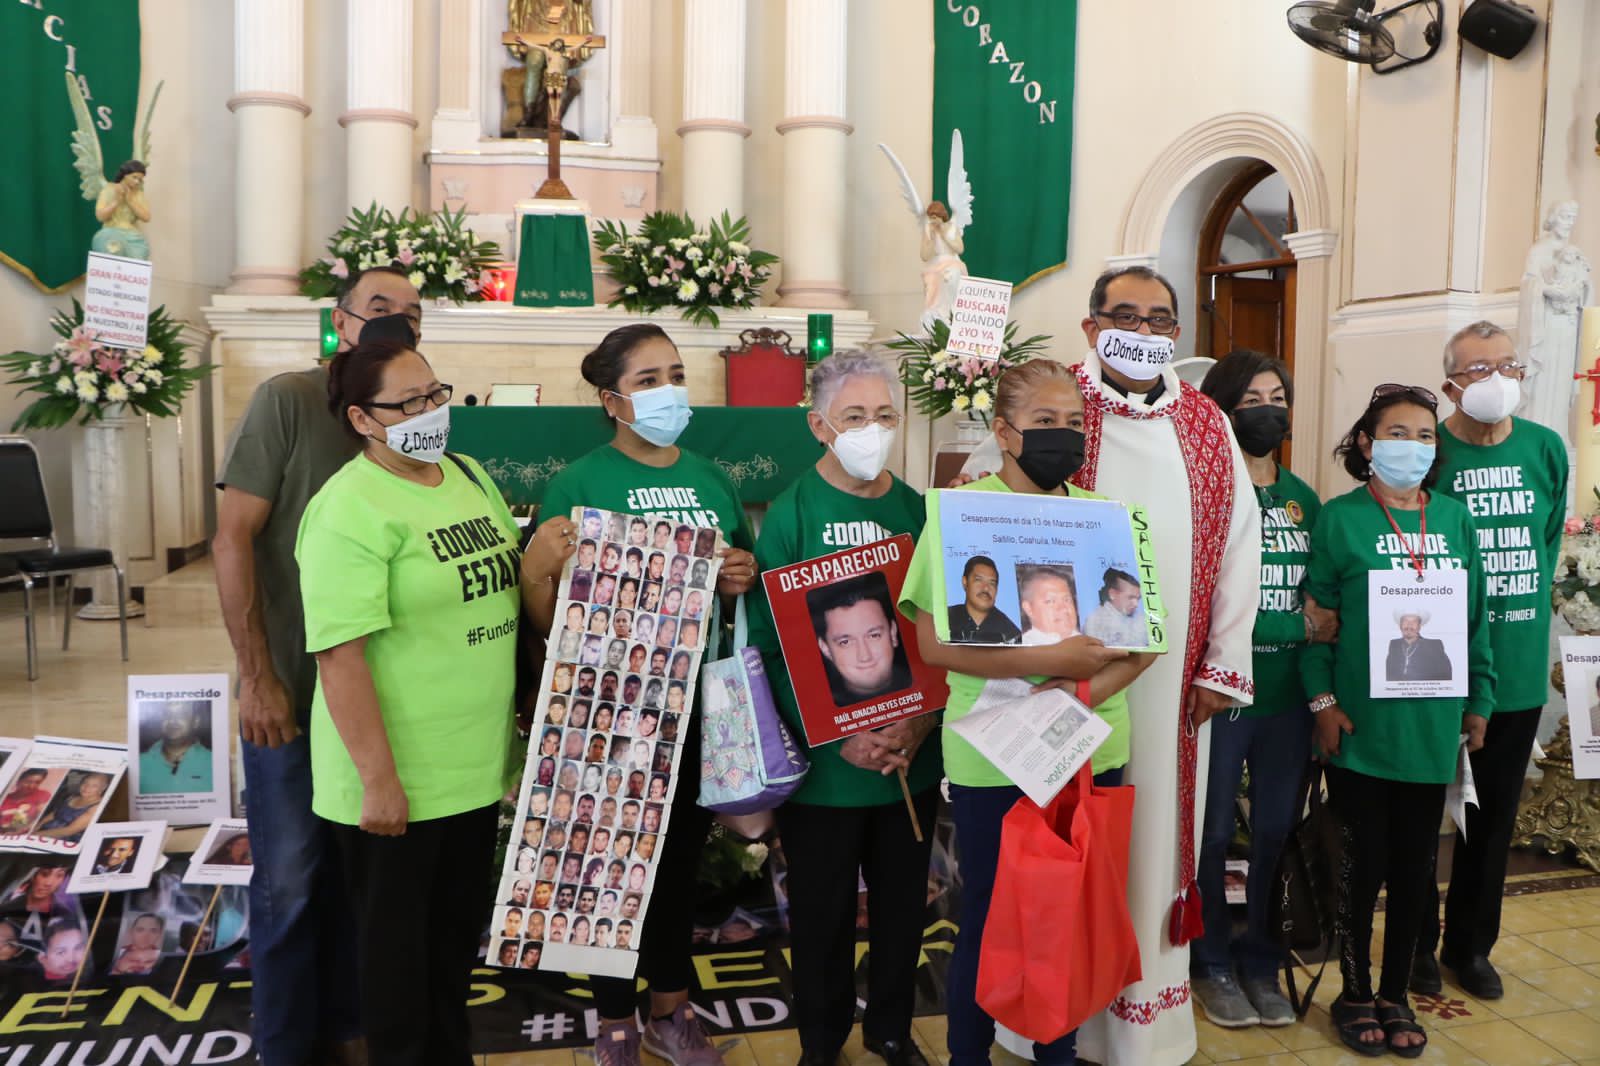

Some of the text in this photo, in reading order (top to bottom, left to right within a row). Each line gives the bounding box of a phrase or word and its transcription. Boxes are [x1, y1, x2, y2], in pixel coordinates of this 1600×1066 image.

[954, 311, 1004, 329] CUANDO
[949, 339, 966, 350] NO
[1103, 336, 1144, 362] ¿Dónde
[1453, 466, 1523, 492] ¿DONDE
[627, 487, 701, 510] ¿DONDE
[1466, 490, 1536, 517] ESTAN?
[1052, 519, 1073, 529] Marzo
[427, 516, 506, 563] ¿DONDE
[1376, 533, 1449, 555] ¿DONDE
[1497, 526, 1532, 549] UNA
[779, 542, 901, 592] DESAPARECIDO
[1380, 585, 1454, 597] Desaparecido
[1486, 572, 1540, 597] NSABLE
[135, 688, 222, 700] Desaparecido
[851, 704, 878, 720] IGNACIO
[877, 699, 899, 712] REYES
